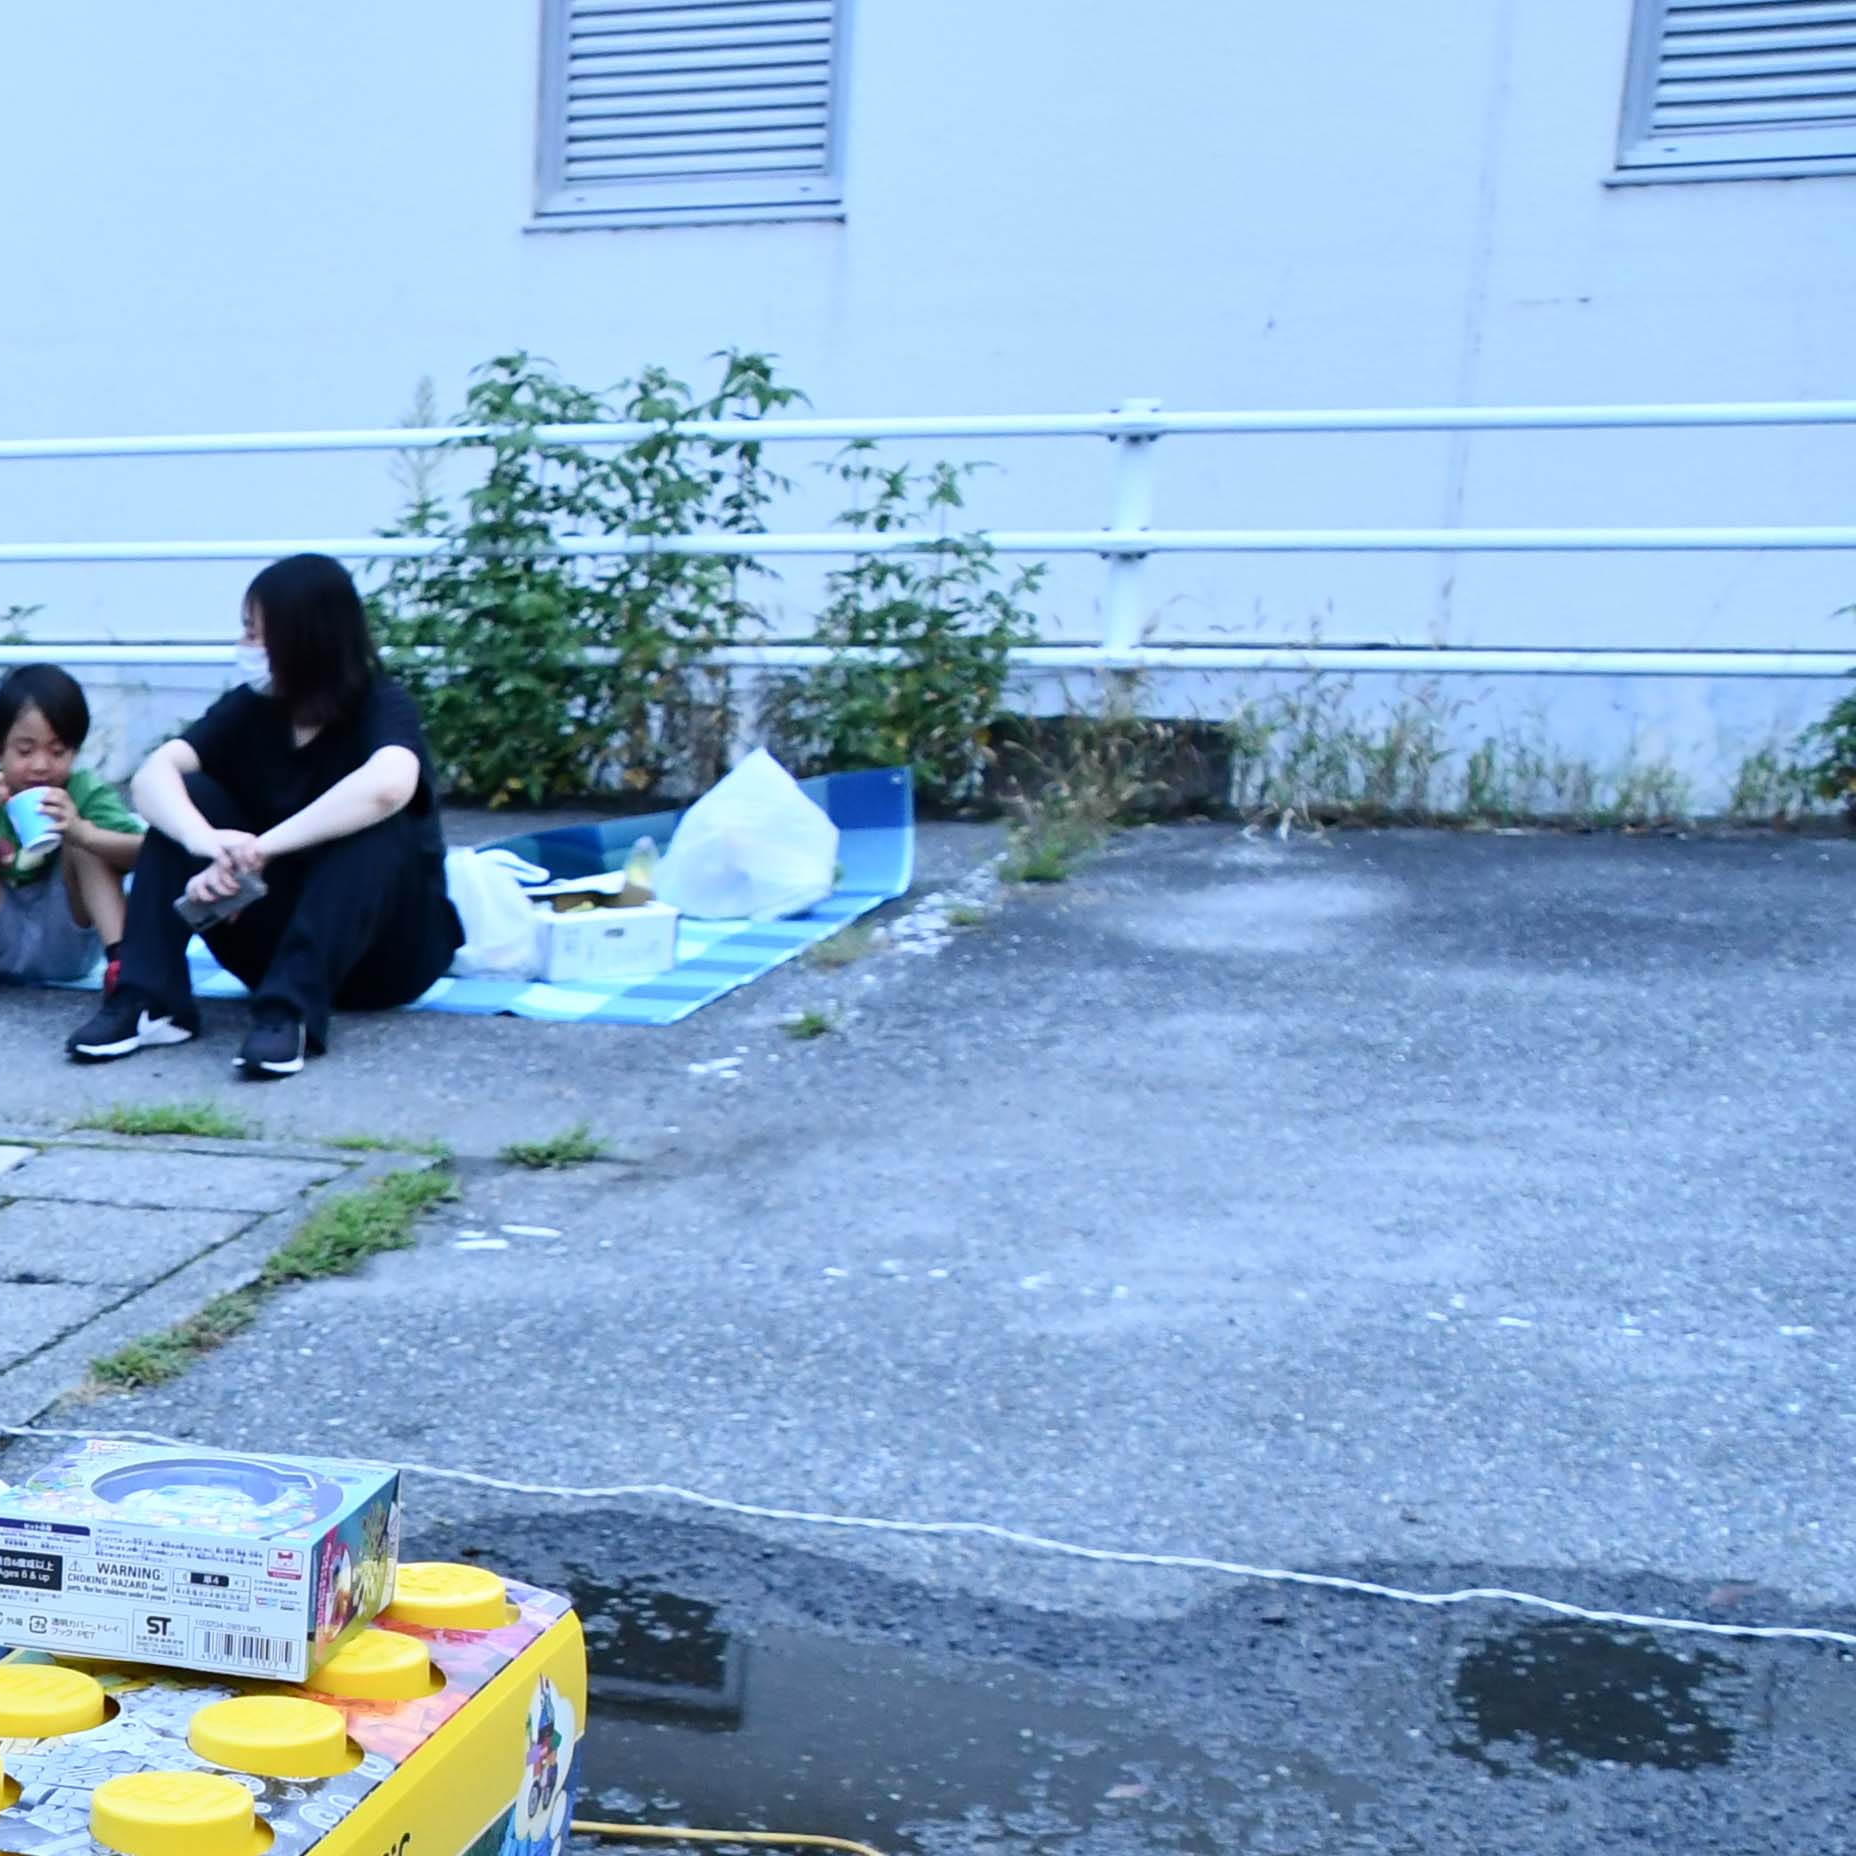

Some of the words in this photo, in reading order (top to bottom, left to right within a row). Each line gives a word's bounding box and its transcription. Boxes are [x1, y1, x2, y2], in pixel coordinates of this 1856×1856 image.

[21, 1569, 28, 1580] 6
[29, 1570, 37, 1580] &
[39, 1573, 51, 1583] up
[96, 1561, 165, 1582] WARNING:
[67, 1572, 109, 1587] CHOKING
[110, 1575, 148, 1590] HAZARD
[6, 1616, 24, 1627] 外箱
[146, 1615, 173, 1637] ST
